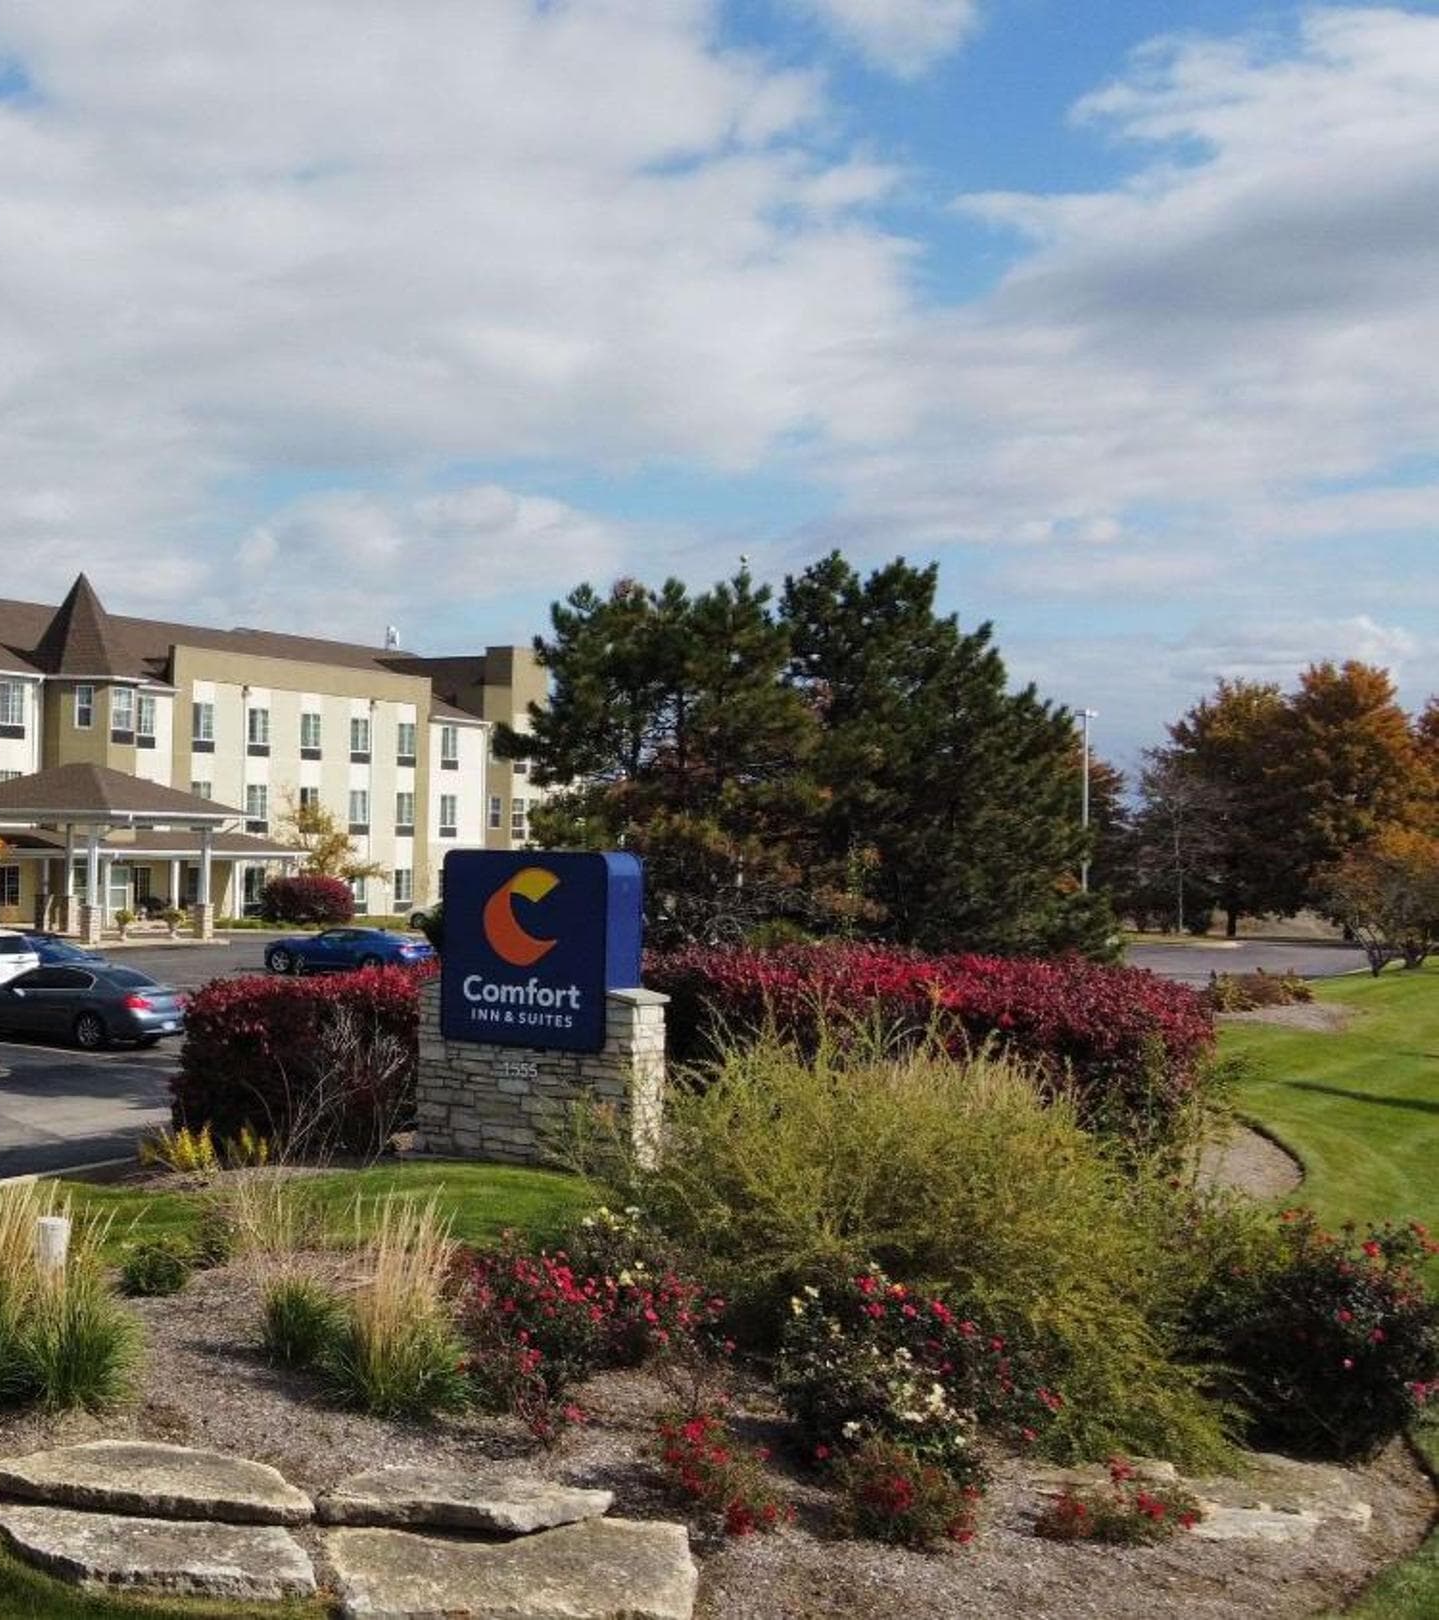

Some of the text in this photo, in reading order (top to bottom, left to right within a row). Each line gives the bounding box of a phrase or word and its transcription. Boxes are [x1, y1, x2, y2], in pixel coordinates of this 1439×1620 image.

[463, 974, 580, 1010] Comfort
[471, 1007, 573, 1028] INN & SUITES
